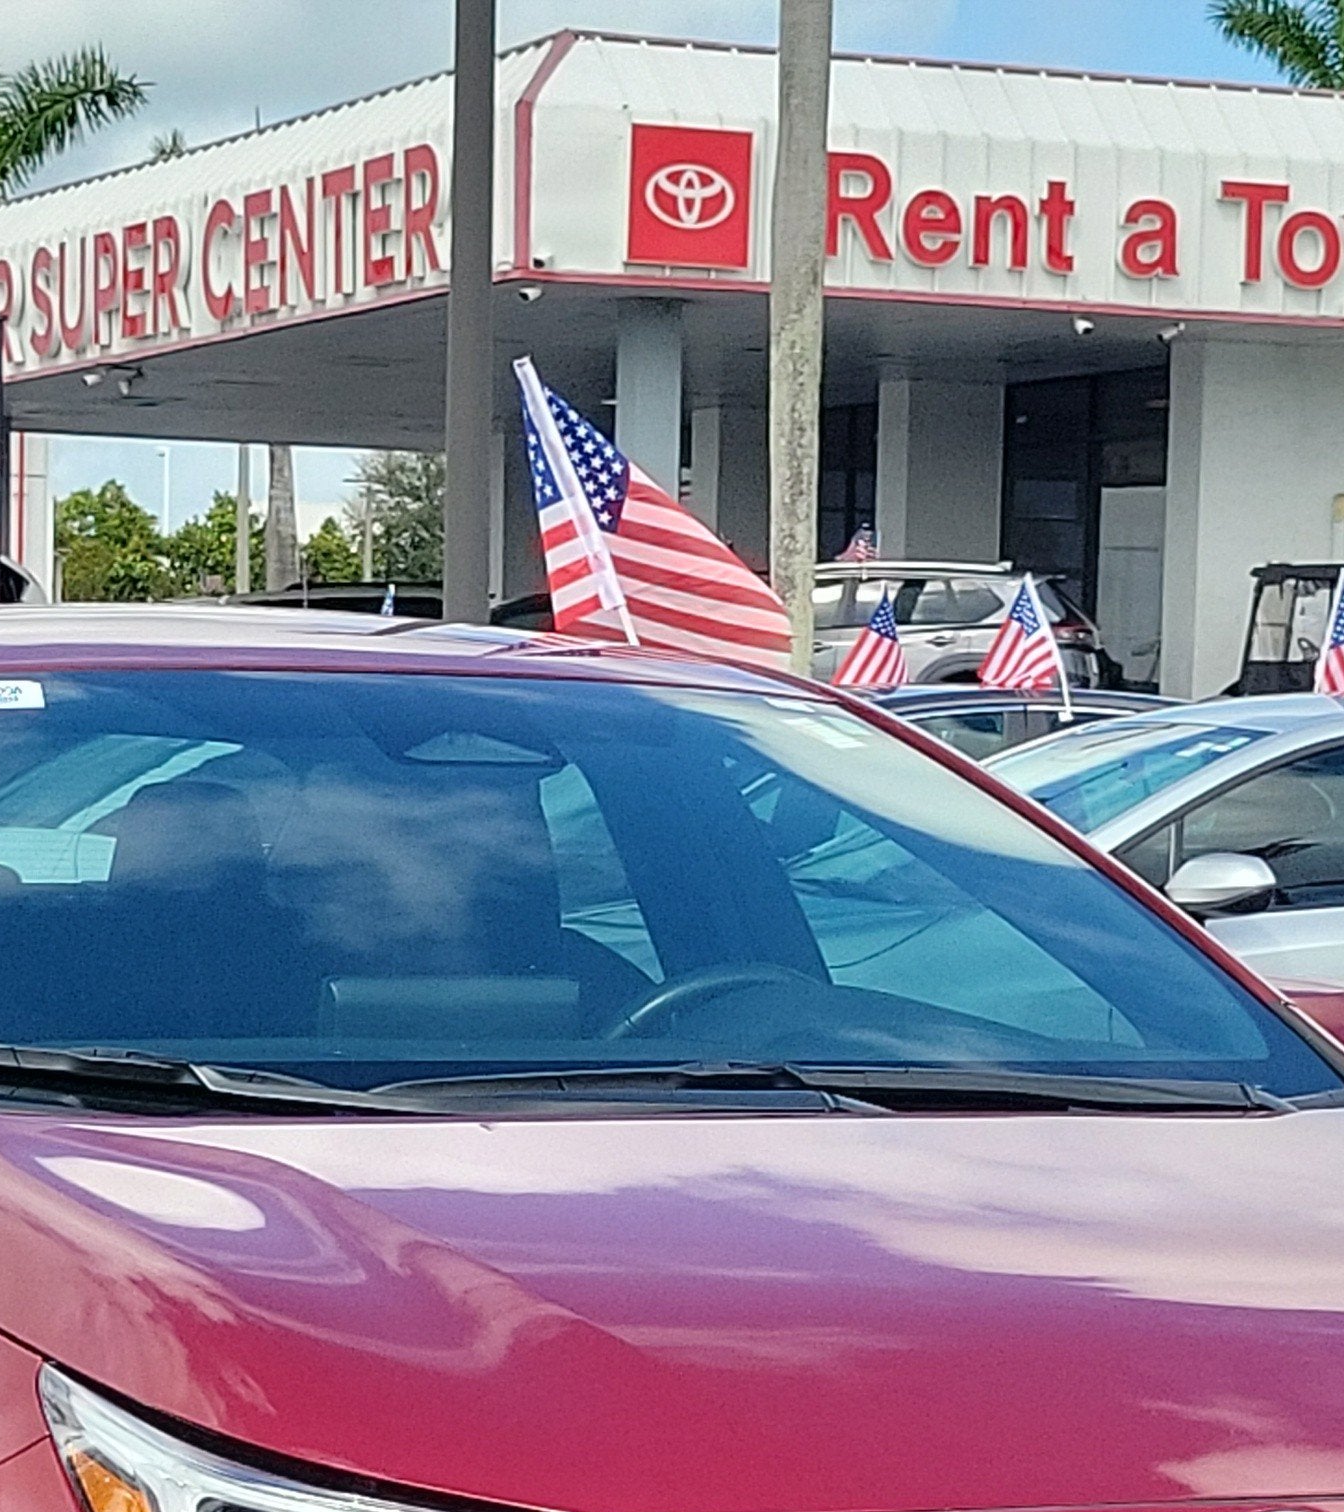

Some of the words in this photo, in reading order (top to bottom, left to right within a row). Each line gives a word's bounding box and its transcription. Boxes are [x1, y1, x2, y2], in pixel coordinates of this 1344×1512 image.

[30, 214, 183, 357] SUPER
[201, 143, 442, 321] CENTER
[825, 151, 1076, 272] Rent
[1117, 197, 1180, 279] a
